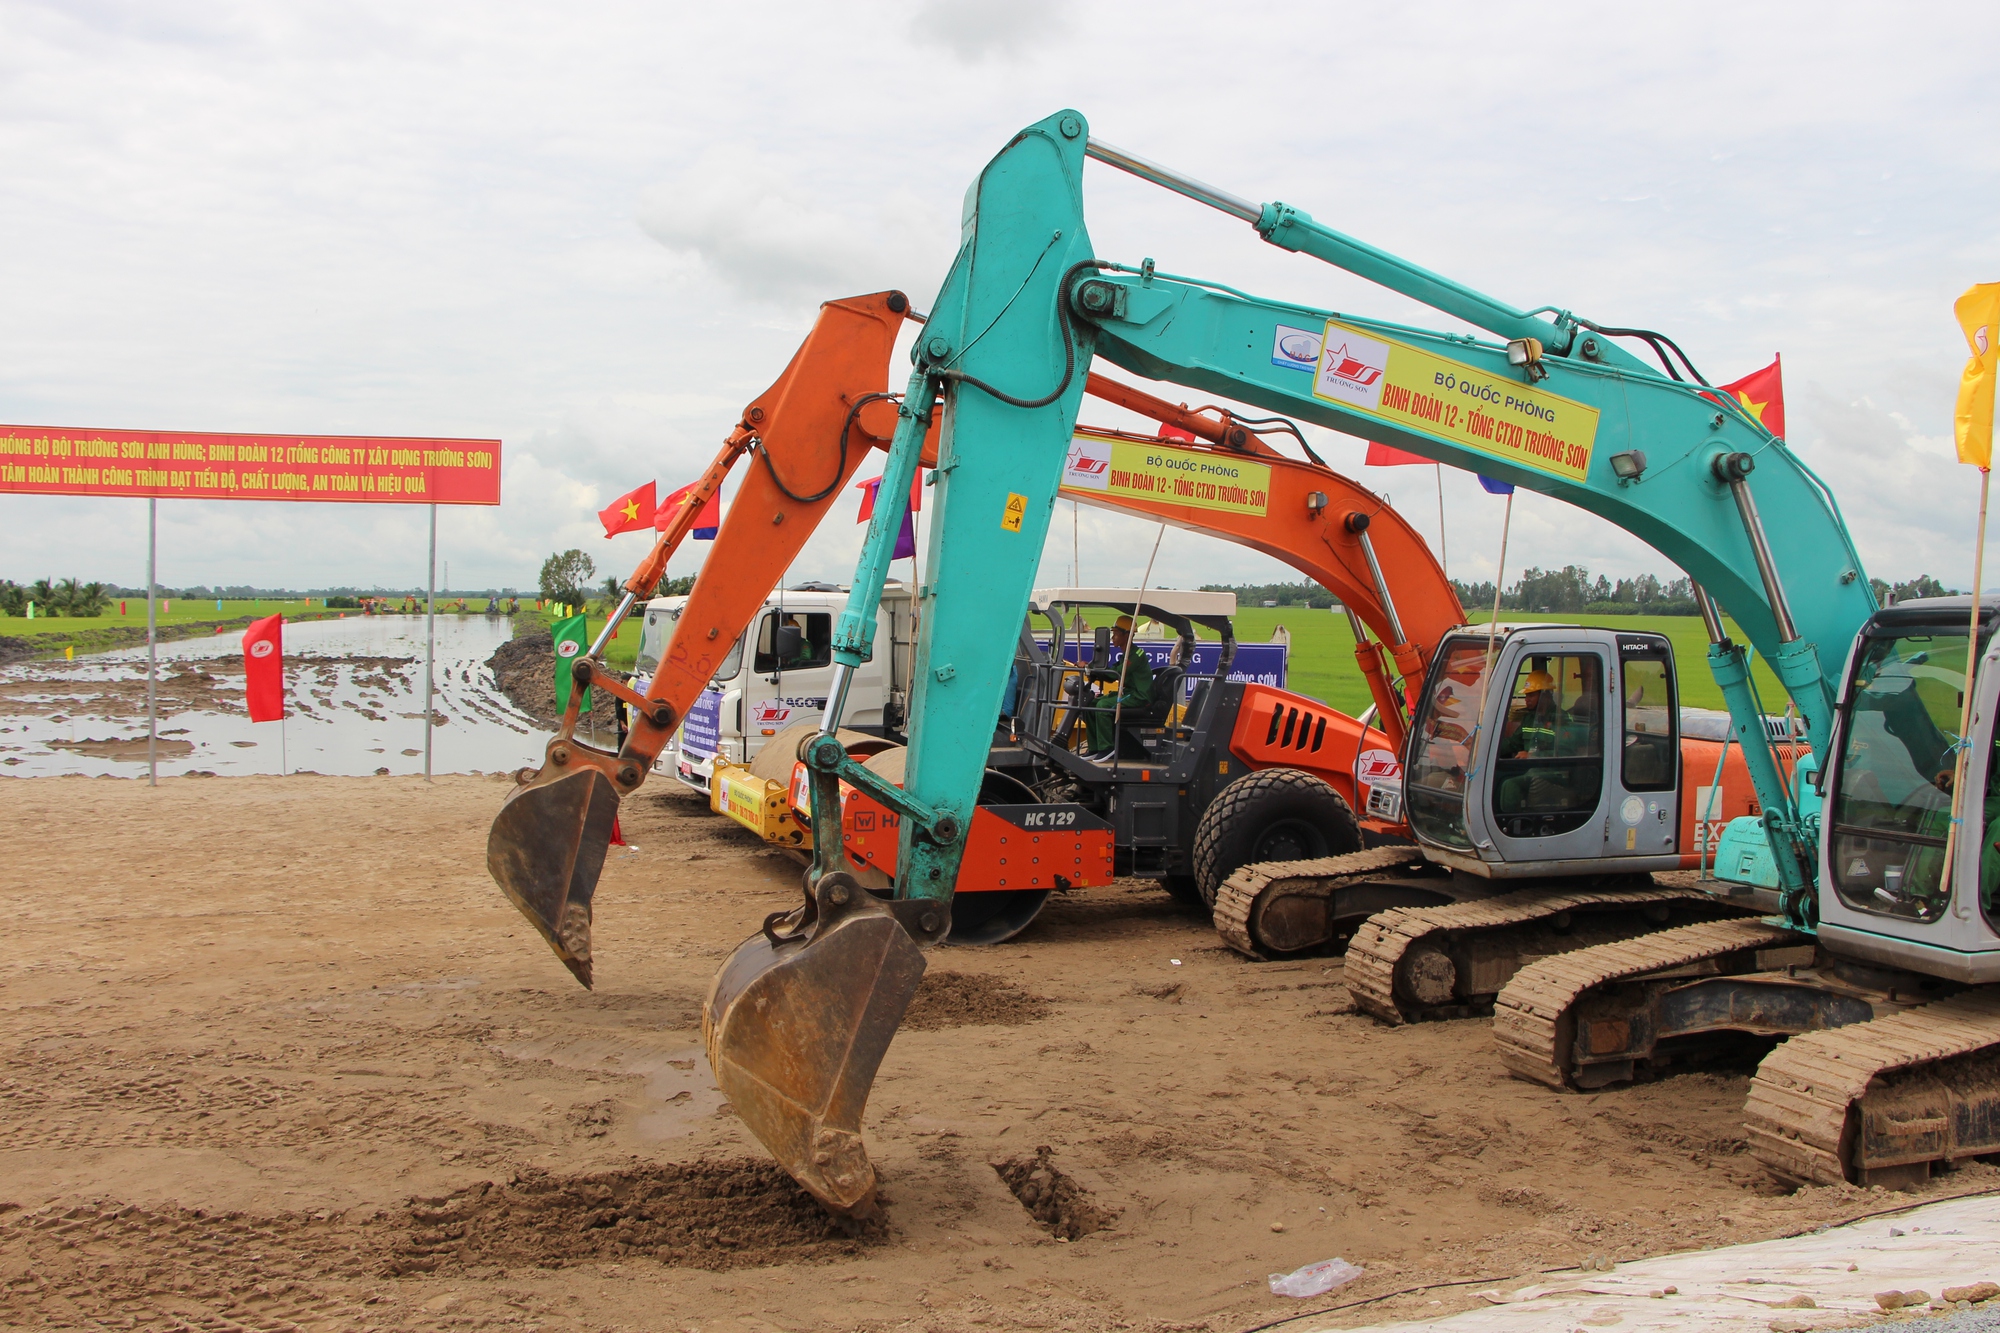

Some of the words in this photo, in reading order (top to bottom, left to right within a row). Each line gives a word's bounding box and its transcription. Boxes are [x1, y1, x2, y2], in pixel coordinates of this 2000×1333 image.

[1434, 372, 1456, 391] BỘ
[1460, 381, 1501, 404] QUỐC
[1505, 395, 1555, 422] PHÒNG
[1382, 383, 1411, 412] BINH
[1411, 392, 1443, 423] ĐOÀN
[1444, 404, 1458, 428] 12
[1466, 405, 1494, 440] TỔNG
[1495, 420, 1523, 448] CTXD
[1524, 430, 1564, 462] TRƯỜNG
[1566, 444, 1588, 470] SƠN
[34, 436, 49, 459] BỘ
[52, 436, 71, 460] ĐỘI
[74, 437, 118, 458] TRƯỜNG
[121, 440, 144, 458] SƠN
[147, 443, 170, 460] ANH
[173, 440, 206, 462] HÙNG;
[209, 444, 235, 462] BINH
[238, 442, 268, 462] ĐOÀN
[270, 447, 284, 463] 12
[286, 441, 318, 464] (TỔNG
[321, 445, 350, 464] CÔNG
[353, 448, 365, 464] TY
[368, 446, 389, 465] XÂY
[392, 448, 420, 470] DỰNG
[423, 447, 464, 468] TRƯỜNG
[467, 450, 492, 470] SƠN)
[1146, 455, 1162, 468] BỘ
[1166, 458, 1197, 472] QUỐC
[1200, 464, 1239, 478] PHÒNG
[1, 462, 26, 482] TÂM
[28, 464, 60, 484] HOÀN
[62, 464, 99, 485] THÀNH
[102, 466, 132, 486] CÔNG
[135, 467, 168, 486] TRÌNH
[170, 471, 191, 490] ĐẠT
[194, 466, 218, 488] TIẾN
[221, 469, 238, 492] ĐỘ,
[242, 468, 269, 490] CHẤT
[272, 472, 310, 494] LƯỢNG,
[313, 474, 328, 490] AN
[331, 472, 358, 492] TOÀN
[362, 472, 374, 492] VÀ
[378, 473, 402, 496] HIỆU
[404, 472, 426, 494] QUẢ
[1110, 470, 1130, 488] BINH
[1132, 471, 1154, 492] ĐOÀN
[1157, 477, 1166, 493] 12
[1174, 474, 1194, 497] TỔNG
[1196, 482, 1216, 500] CTXD
[1218, 484, 1248, 504] TRƯỜNG
[1250, 490, 1266, 508] SƠN
[1024, 812, 1046, 826] HC
[1048, 812, 1076, 826] 129
